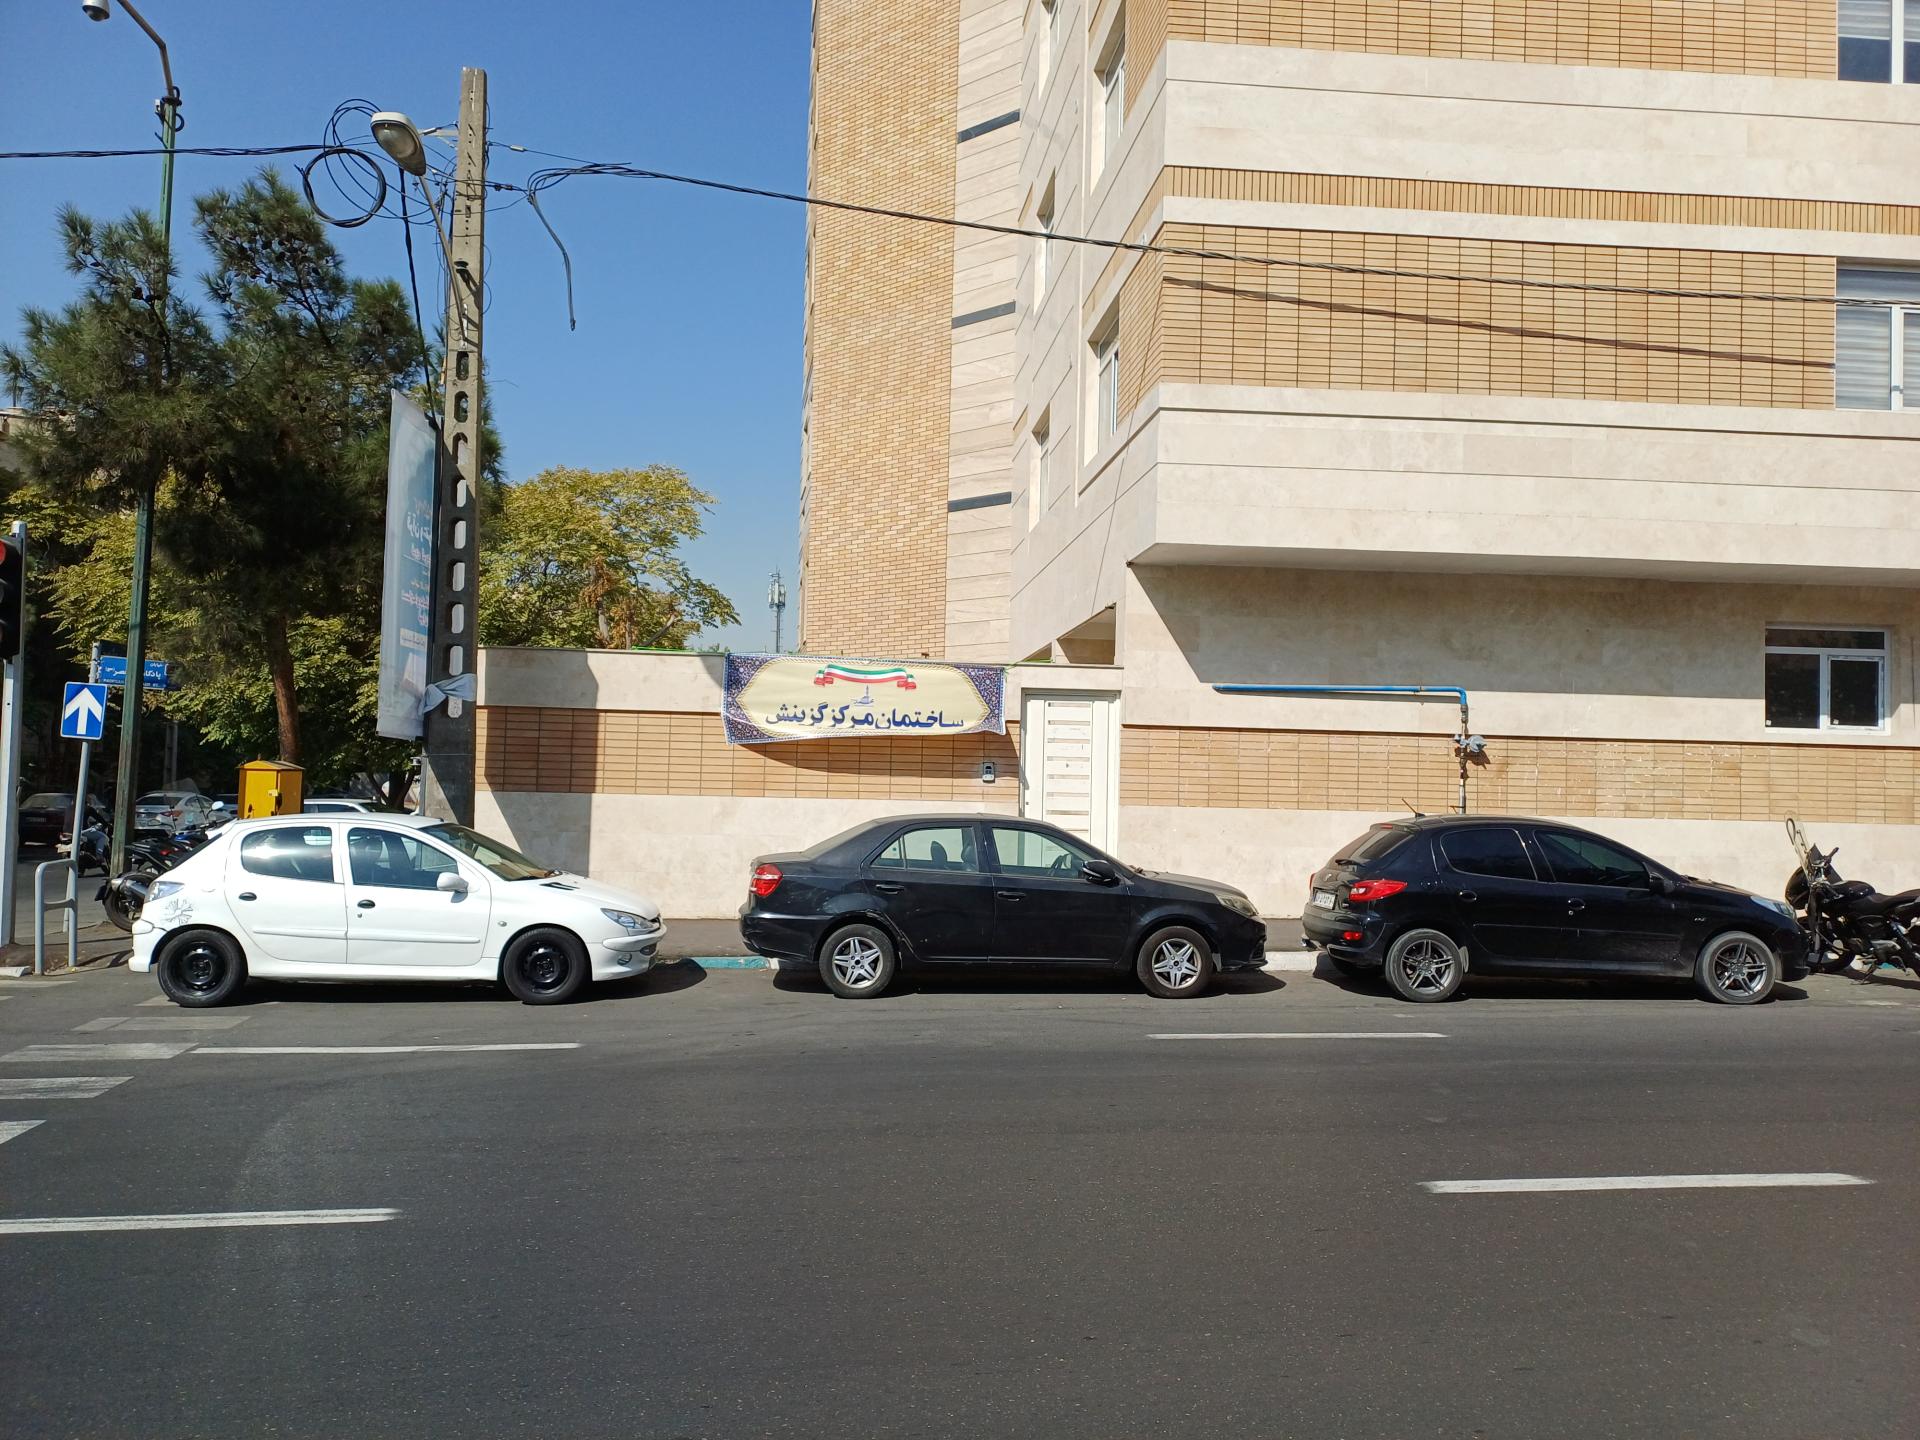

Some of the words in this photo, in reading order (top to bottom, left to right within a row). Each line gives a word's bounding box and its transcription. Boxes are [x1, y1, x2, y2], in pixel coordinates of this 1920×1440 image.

[765, 702, 828, 726] گزینش
[830, 704, 874, 729] مرکز
[875, 708, 964, 730] ساختمان
